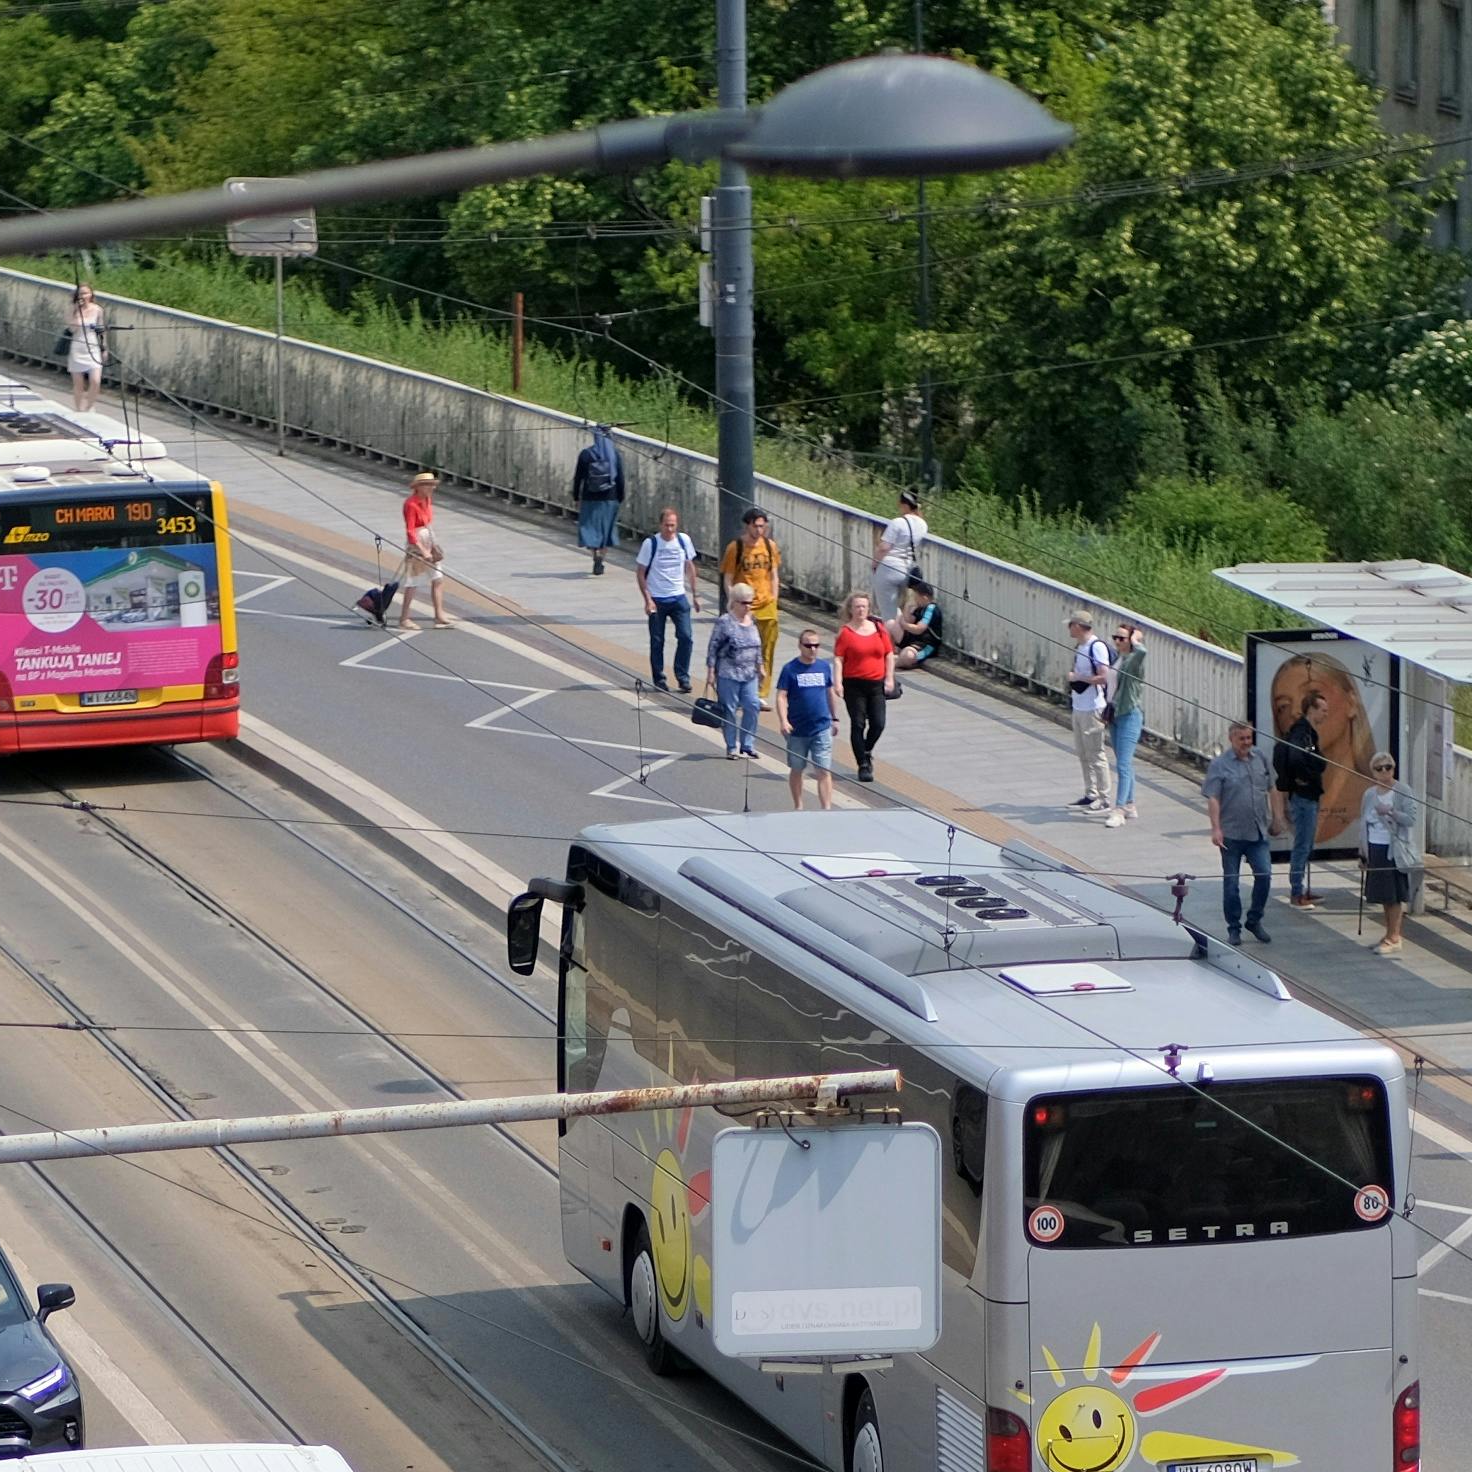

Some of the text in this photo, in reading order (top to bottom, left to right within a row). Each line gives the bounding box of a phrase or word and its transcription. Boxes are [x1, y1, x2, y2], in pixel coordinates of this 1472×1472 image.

[55, 506, 116, 524] CH MARKI
[124, 502, 152, 521] 190
[156, 516, 197, 535] 3453
[15, 655, 74, 671] TANKUJĄ
[77, 652, 121, 667] TANIEJ
[1364, 1195, 1378, 1210] 80
[1036, 1217, 1056, 1231] 100
[1133, 1221, 1289, 1243] SETRA
